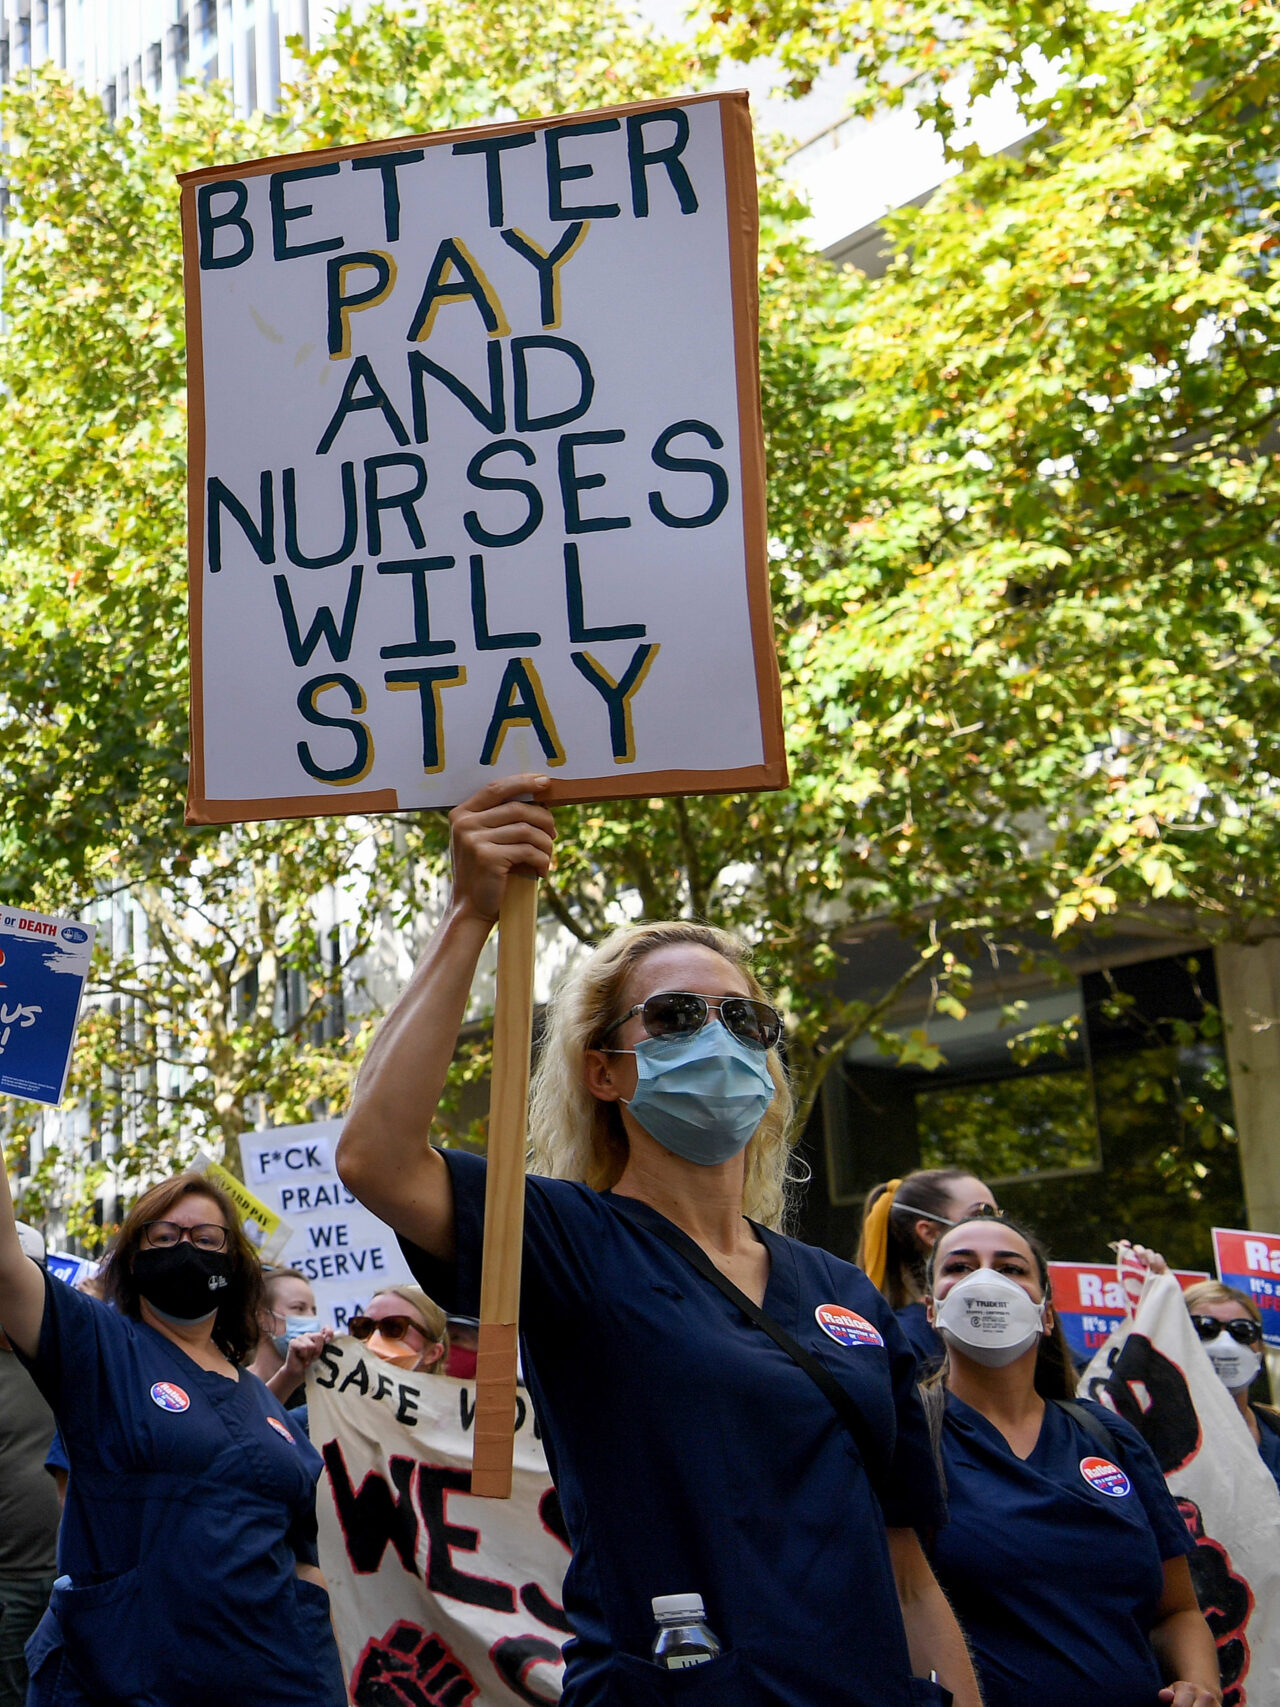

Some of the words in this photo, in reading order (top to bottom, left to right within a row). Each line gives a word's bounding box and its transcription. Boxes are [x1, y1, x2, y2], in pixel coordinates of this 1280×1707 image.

[197, 107, 699, 271] BETTER
[325, 219, 591, 360] PAY
[316, 334, 595, 454] AND
[206, 418, 730, 574] NURSES
[273, 541, 647, 667] WILL
[296, 642, 661, 788] STAY
[4, 916, 16, 926] or
[18, 918, 58, 936] DEATH
[0, 1002, 43, 1028] US
[291, 1248, 385, 1281] ESERVE
[309, 1224, 349, 1248] WE
[820, 1311, 872, 1331] Ratios
[316, 1344, 421, 1427] SAFE
[1084, 1464, 1117, 1479] Ratios
